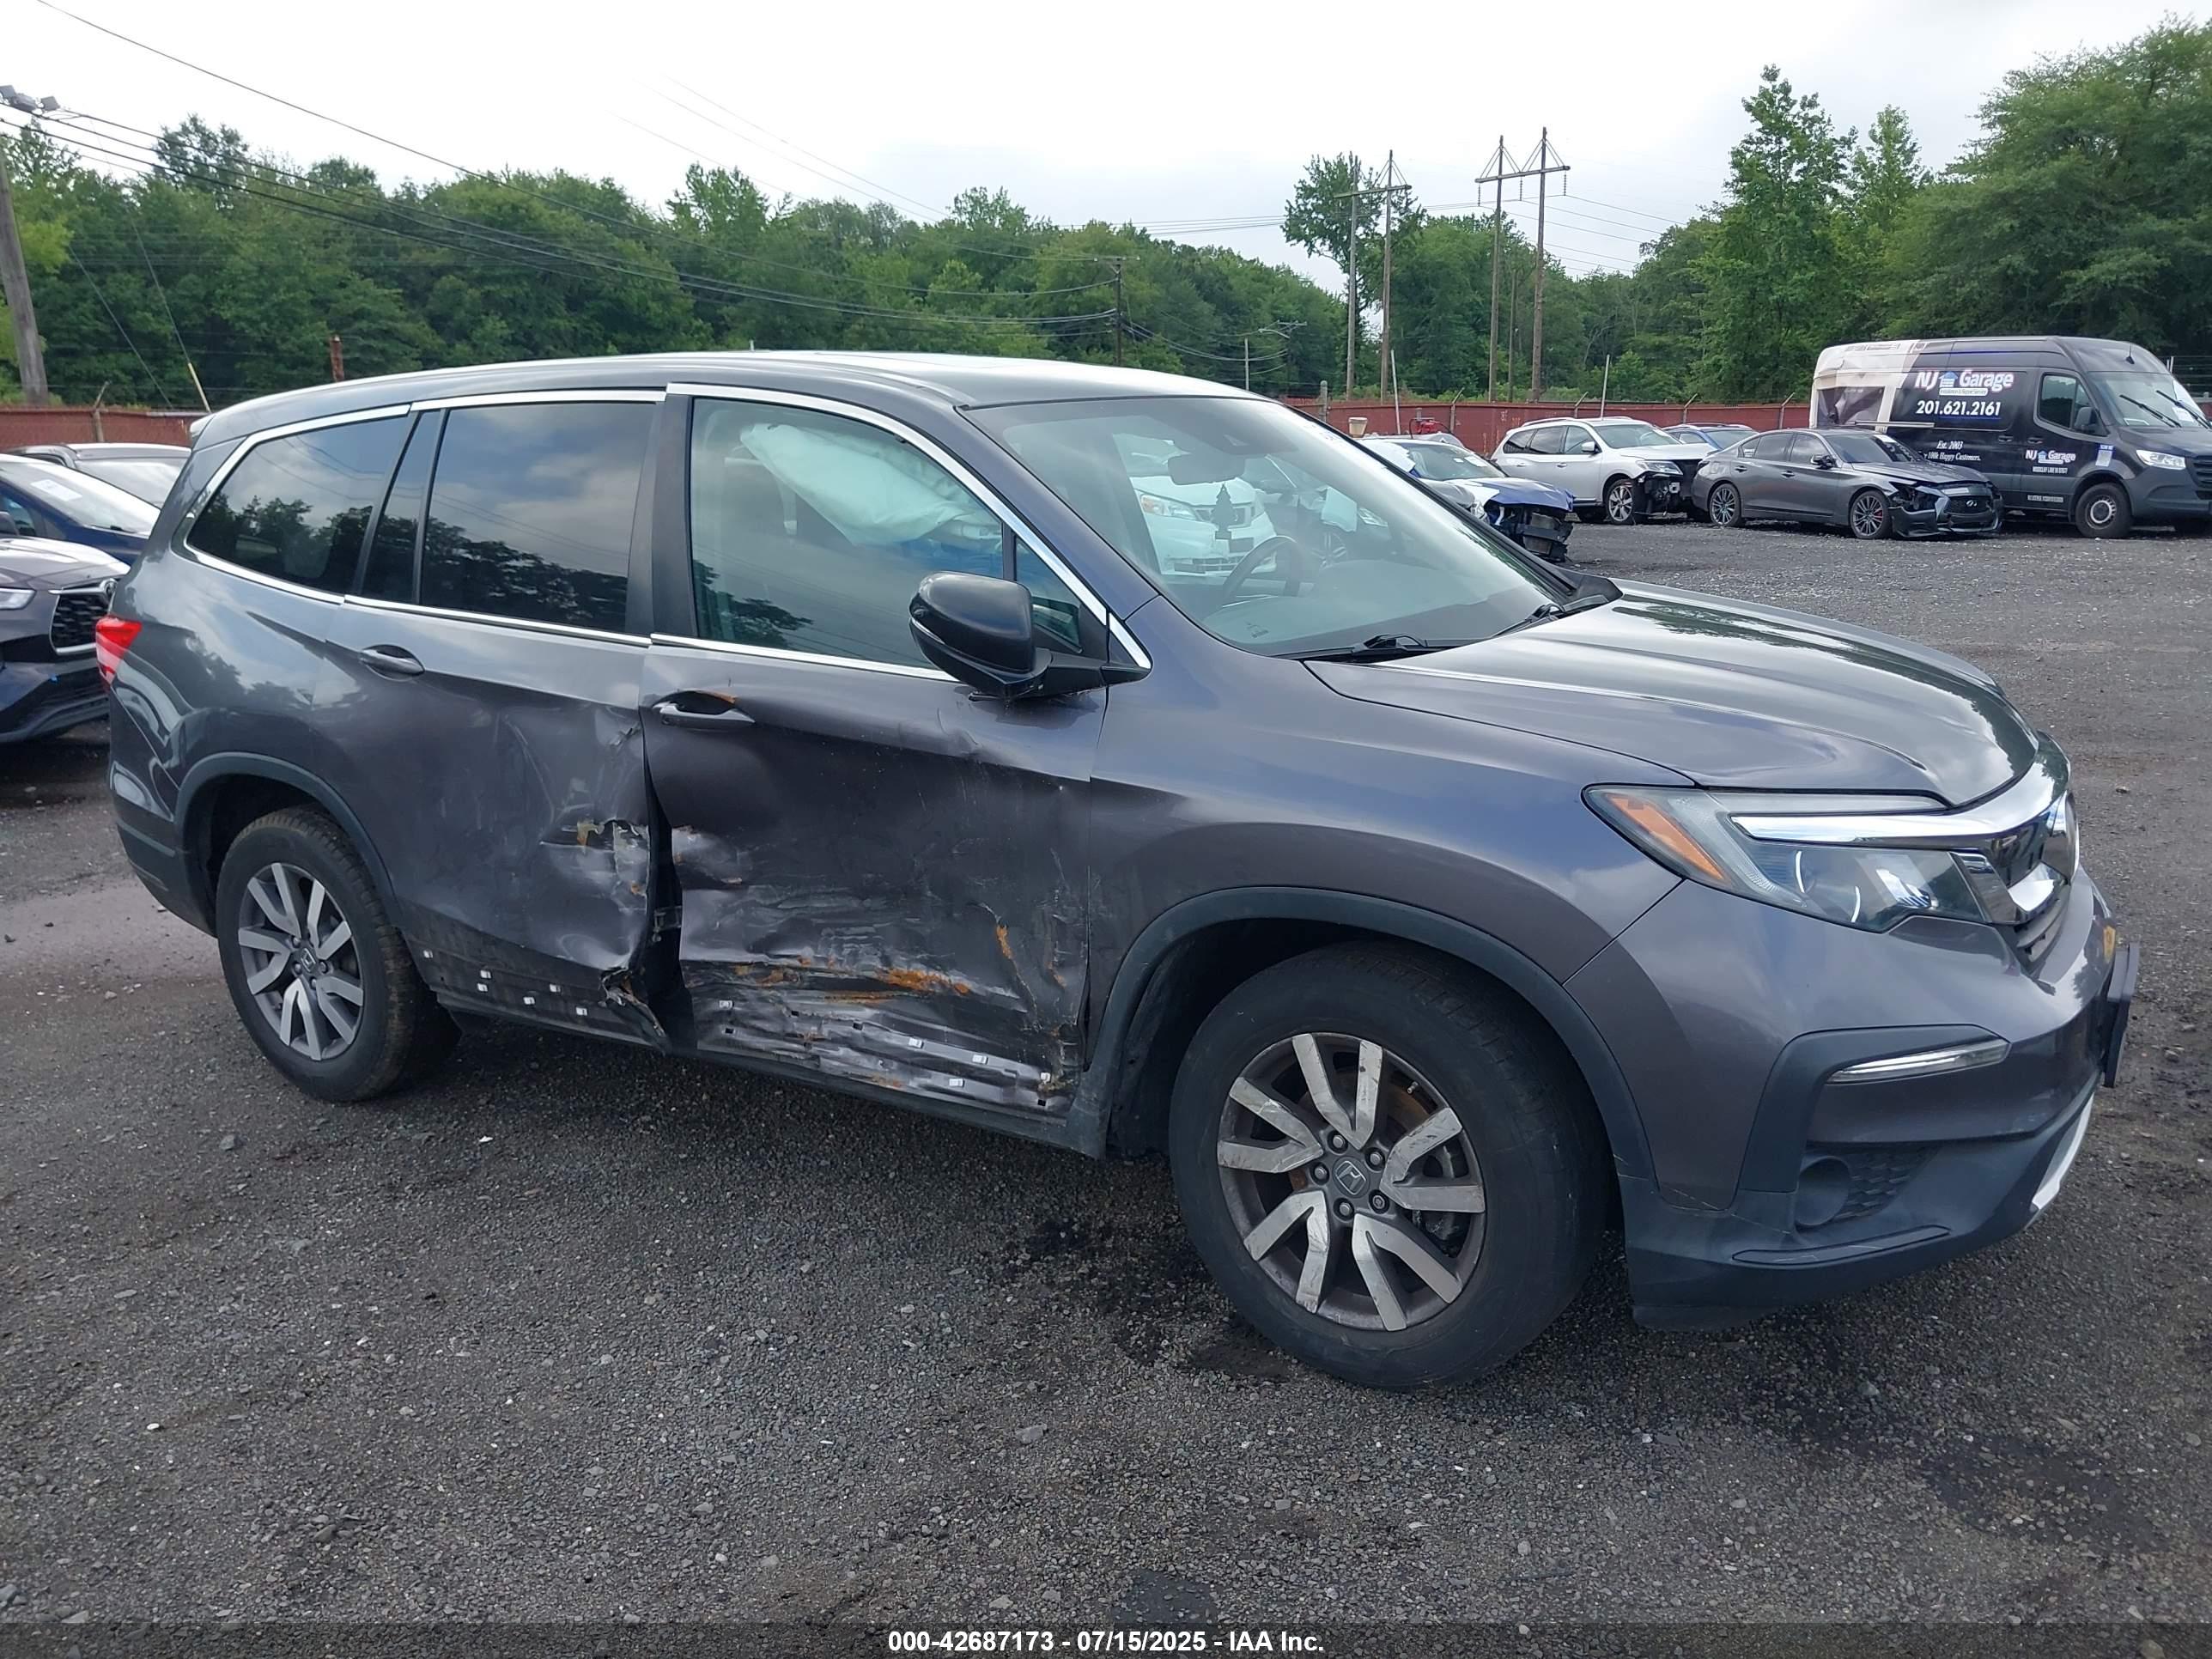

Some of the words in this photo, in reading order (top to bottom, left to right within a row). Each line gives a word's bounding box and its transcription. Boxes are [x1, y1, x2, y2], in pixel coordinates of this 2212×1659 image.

[1914, 371, 1940, 392] NJ
[1959, 369, 2014, 392] Garage
[1916, 400, 2001, 416] 201.621.2161
[2026, 449, 2038, 460] NJ
[2048, 450, 2076, 463] Garage
